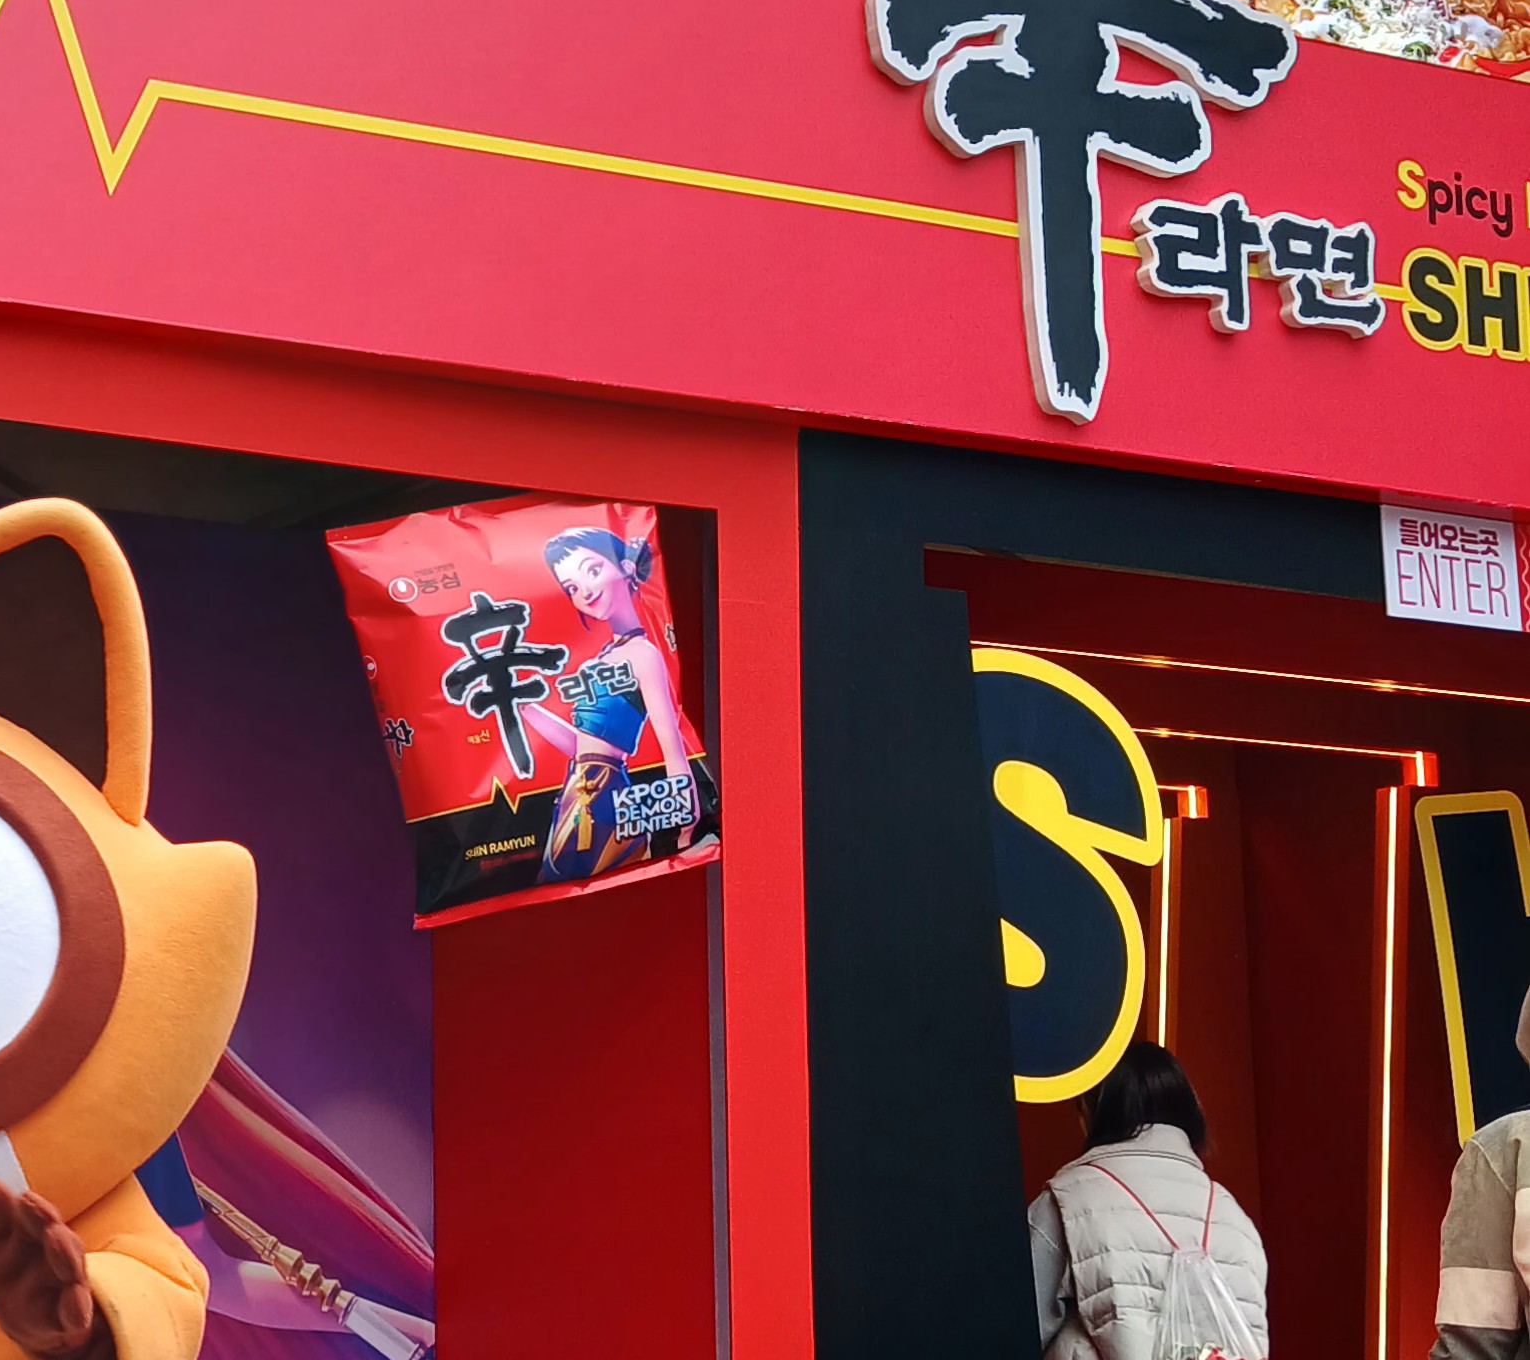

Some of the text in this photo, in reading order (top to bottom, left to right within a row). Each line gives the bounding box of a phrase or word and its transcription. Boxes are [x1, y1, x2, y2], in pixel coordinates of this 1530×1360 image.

[1398, 160, 1513, 238] Spicy
[1131, 192, 1386, 338] 라면
[1405, 251, 1530, 357] SH
[1400, 519, 1499, 557] 들어오는곳
[418, 572, 461, 595] 농심
[1397, 551, 1510, 618] ENTER
[440, 591, 639, 779] 辛 라면
[616, 789, 692, 823] DEMON
[616, 810, 693, 840] HUNTERS
[490, 835, 535, 854] RAMYUN
